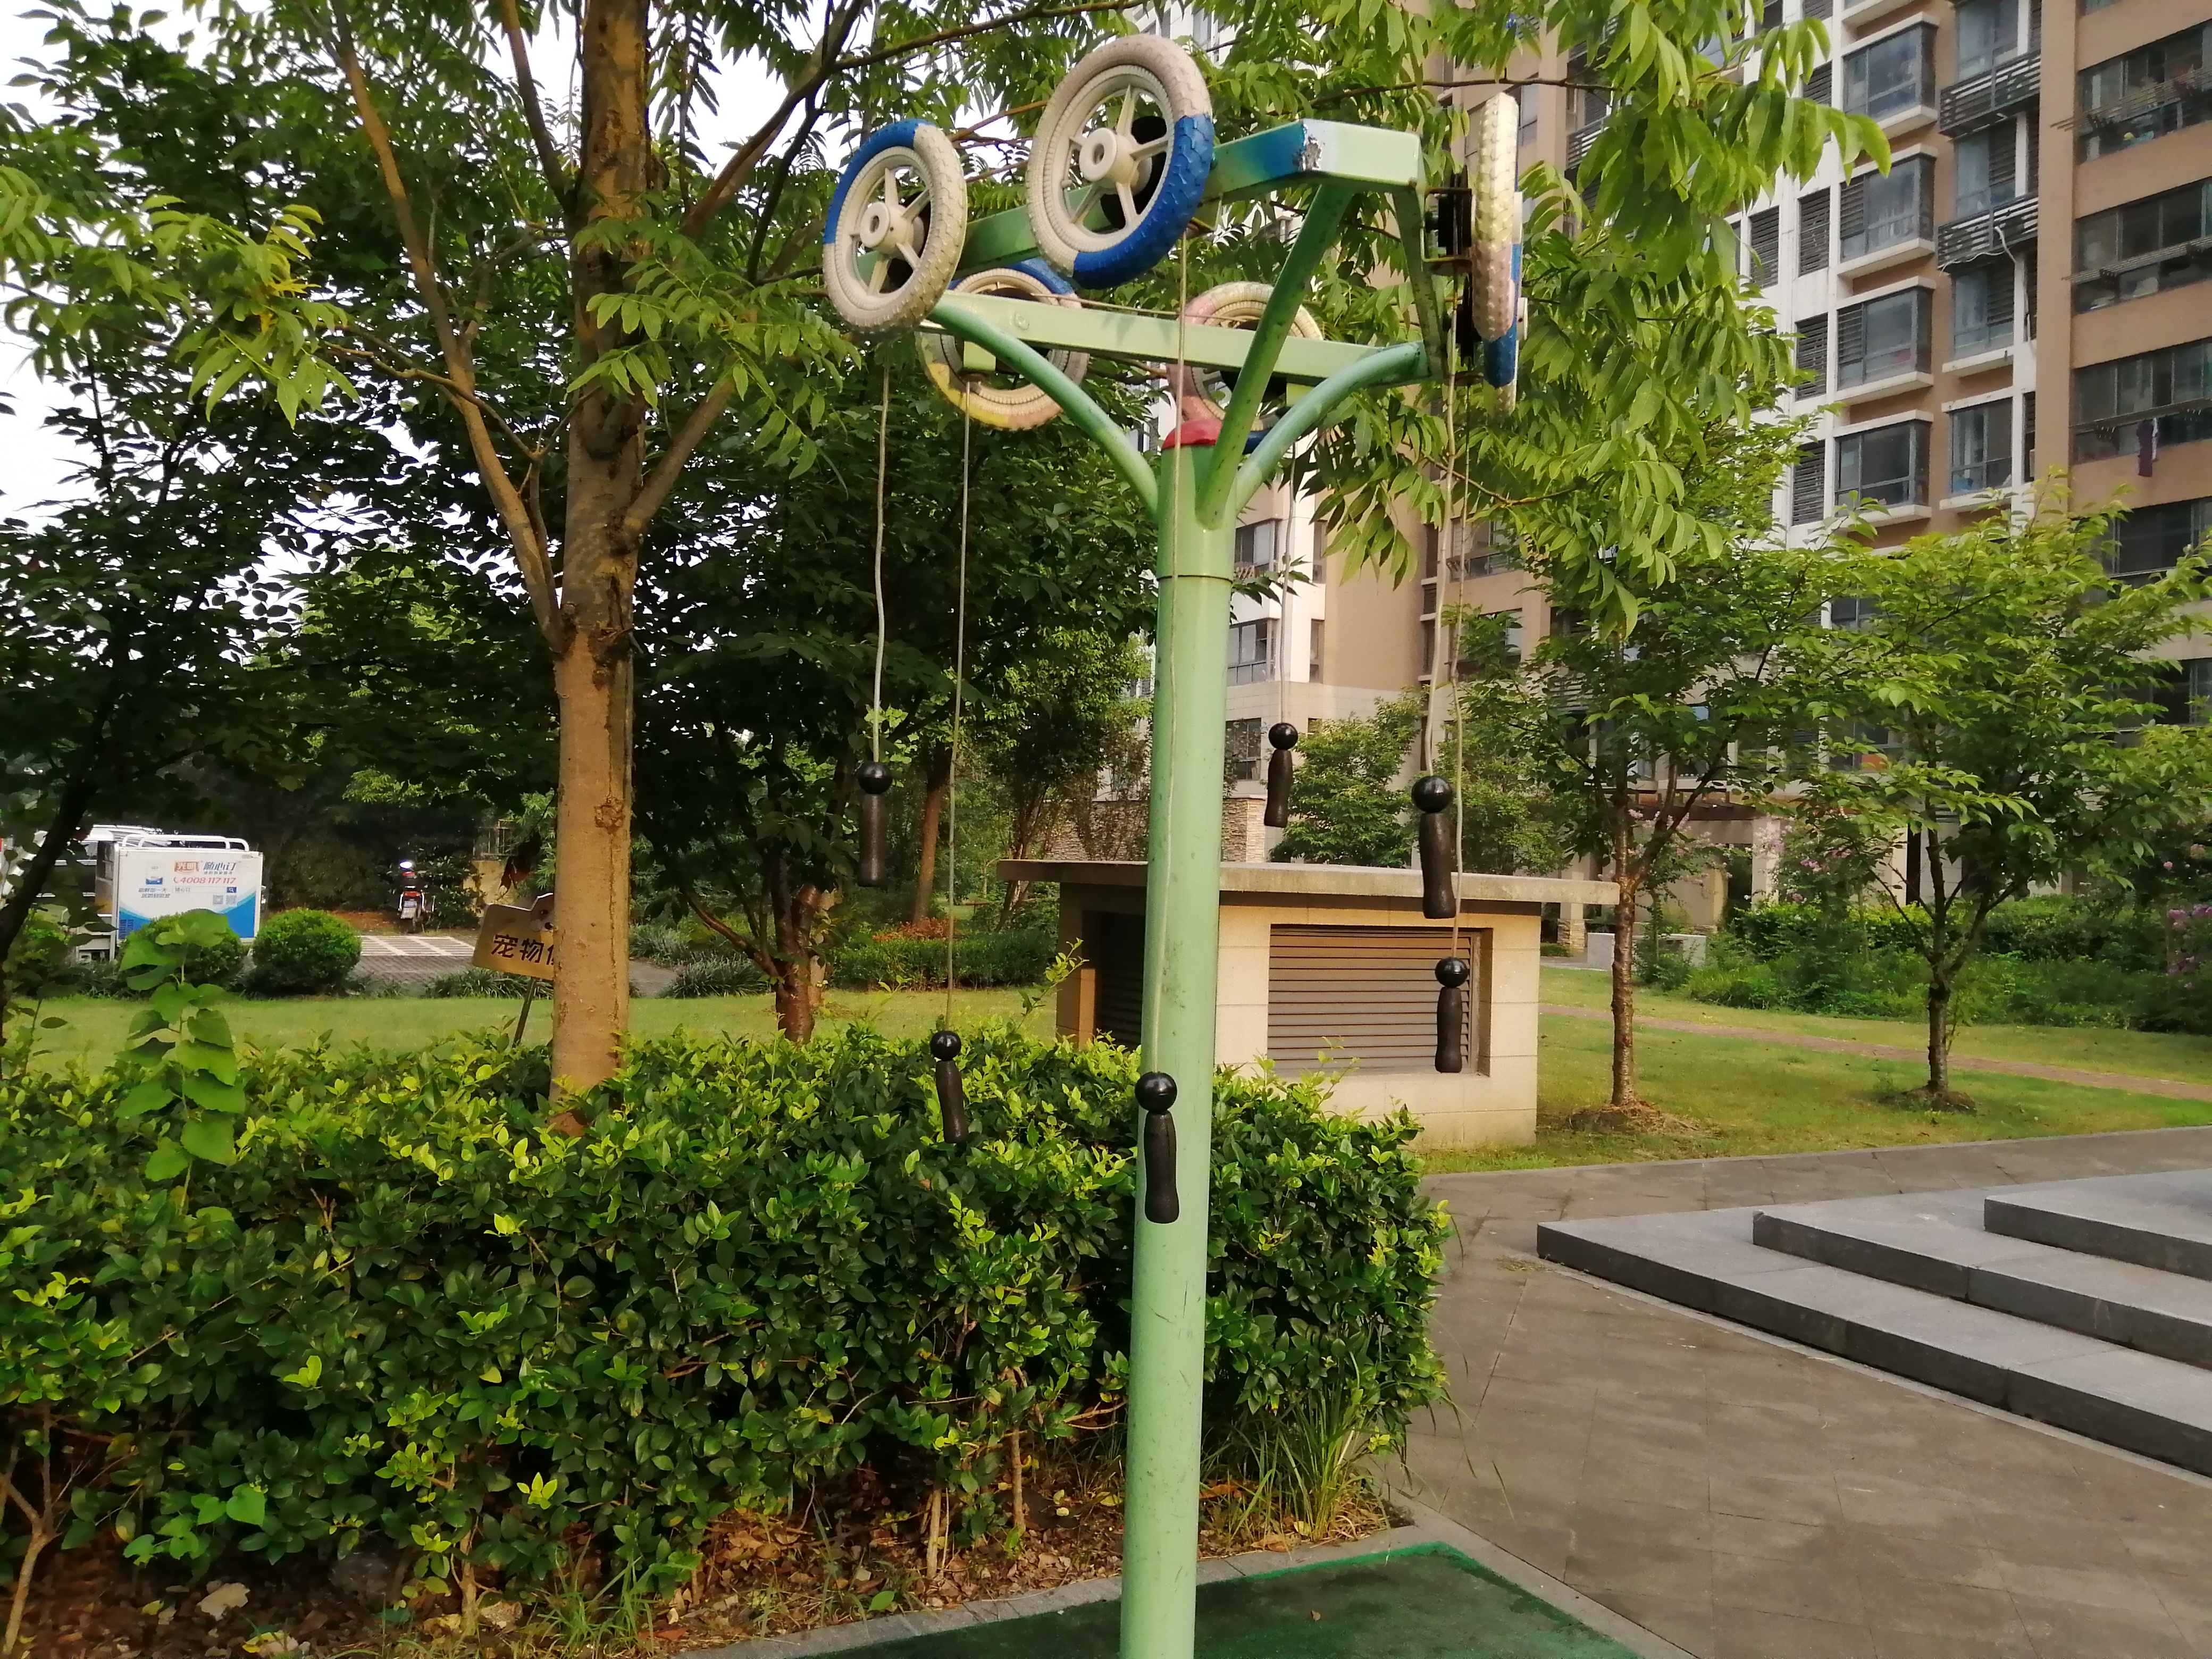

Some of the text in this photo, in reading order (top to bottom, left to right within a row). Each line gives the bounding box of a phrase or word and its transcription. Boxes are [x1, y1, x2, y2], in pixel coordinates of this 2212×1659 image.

[176, 861, 197, 870] 光明
[204, 861, 236, 870] 随心订
